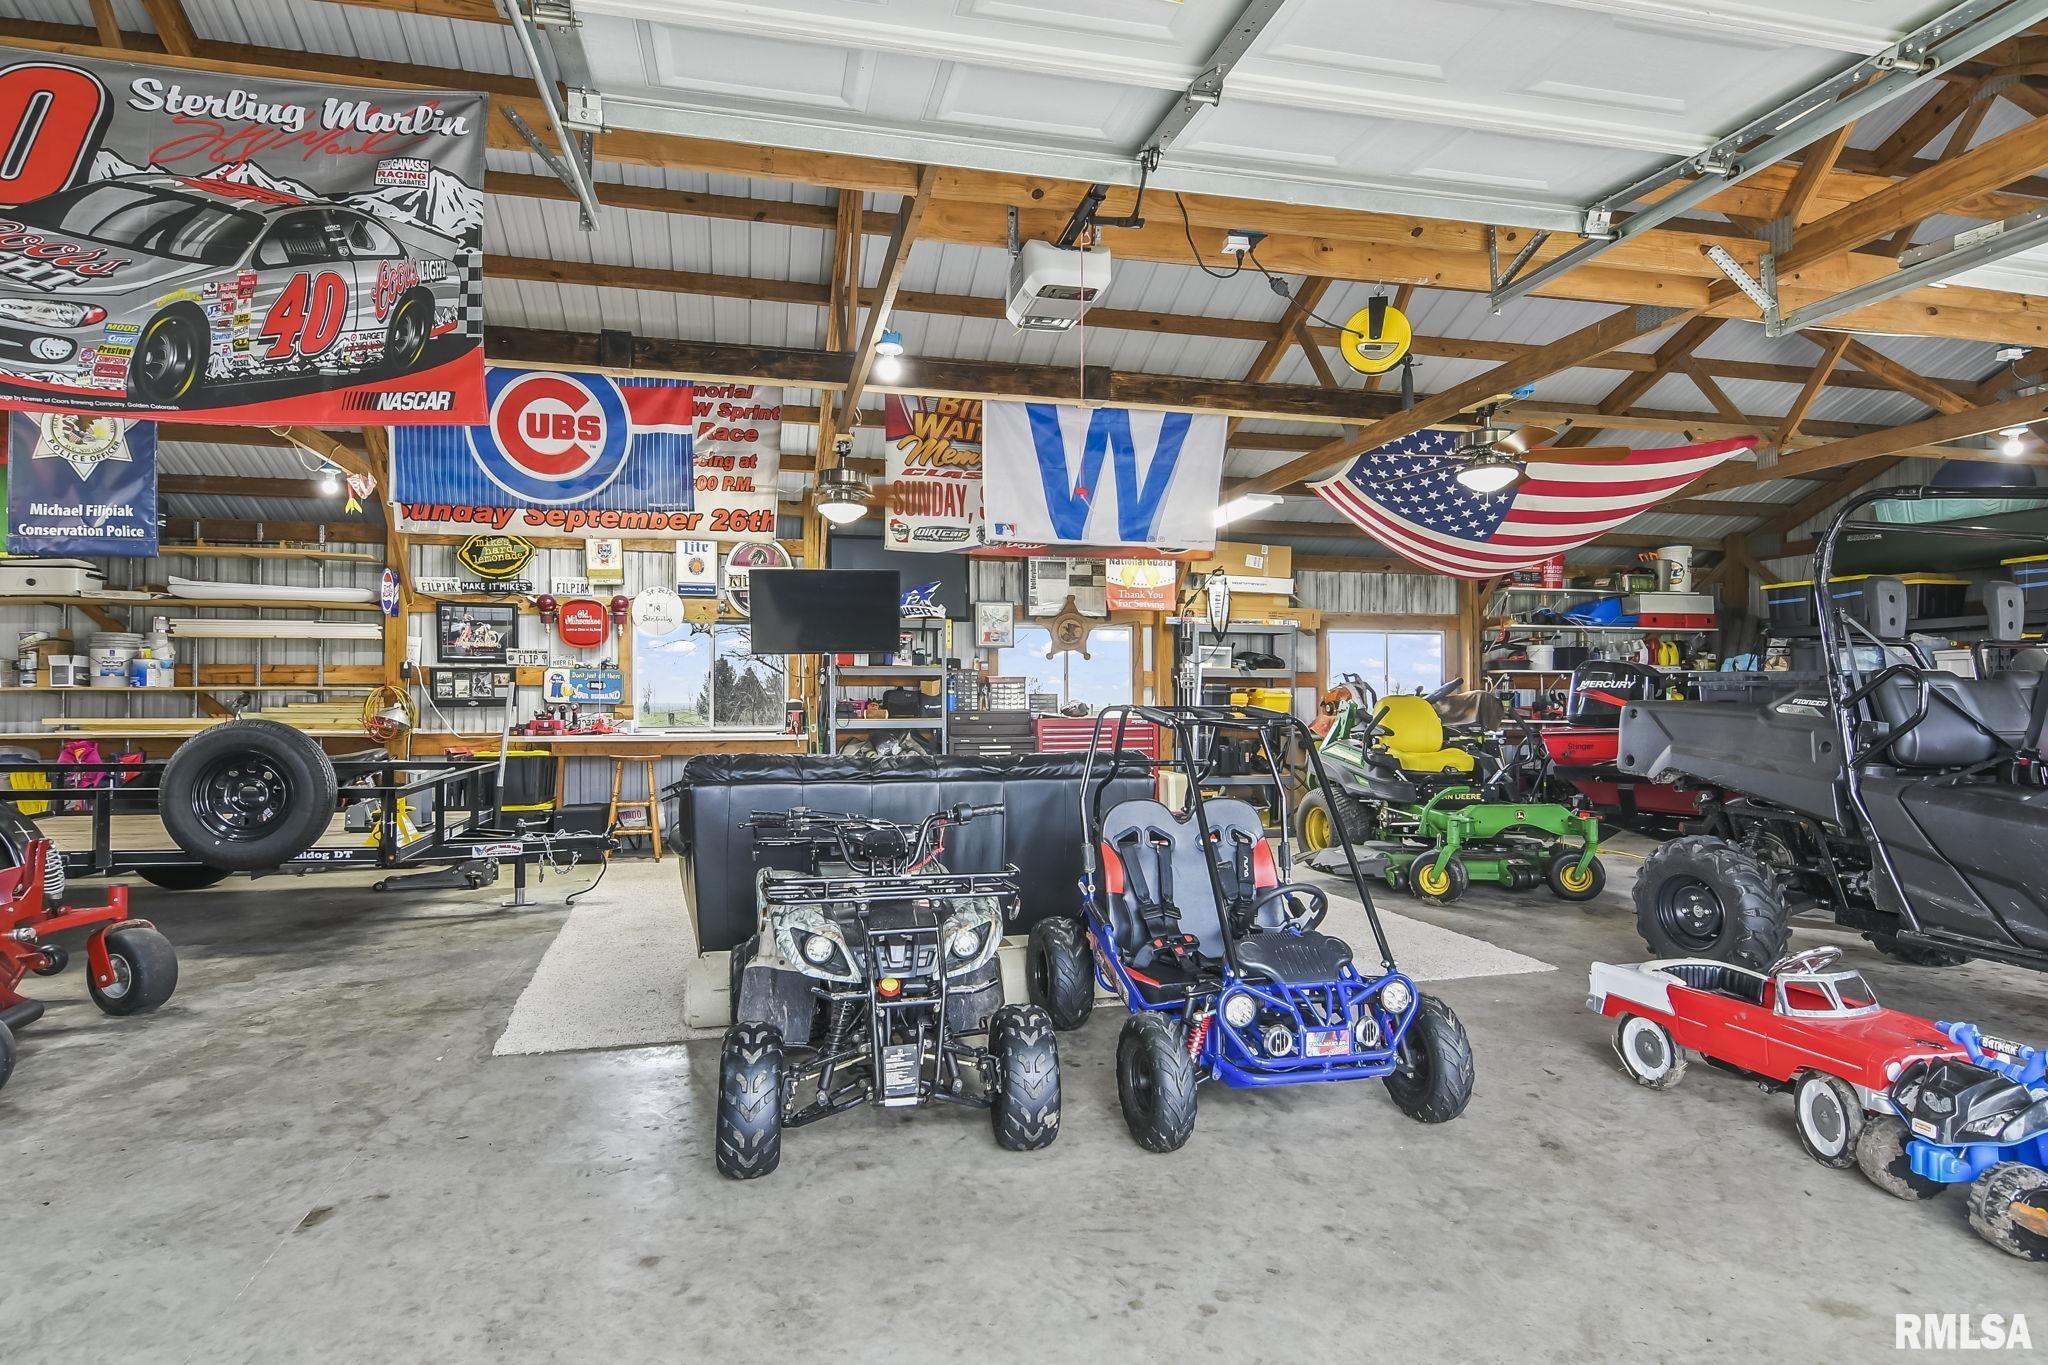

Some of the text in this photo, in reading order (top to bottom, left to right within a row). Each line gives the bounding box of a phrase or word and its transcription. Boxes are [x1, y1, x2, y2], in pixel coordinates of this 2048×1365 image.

[129, 77, 469, 136] Sterling Marlin
[391, 158, 430, 172] GANASSI
[377, 171, 427, 180] RACING
[370, 256, 448, 323] Coors LIGHT
[258, 270, 350, 361] 40
[359, 331, 385, 340] TARGET
[98, 345, 132, 355] Prestone
[377, 391, 451, 411] NASCAR
[717, 402, 780, 422] Sprint
[697, 421, 760, 443] Race
[48, 438, 121, 461] POLICE OFFICER
[739, 453, 758, 469] at
[1025, 402, 1193, 542] W
[721, 475, 756, 493] P.M.
[893, 479, 973, 524] SUNDAY,
[30, 503, 134, 519] Michael Filipiak
[523, 506, 703, 533] September
[709, 507, 775, 533] 26th
[18, 523, 145, 538] Conservation Police
[475, 537, 511, 546] mike's
[684, 541, 709, 556] Lite
[483, 545, 513, 555] hard
[472, 551, 523, 564] lemonade
[1109, 558, 1146, 567] National
[1029, 560, 1038, 590] Volleyball
[421, 581, 457, 592] FILPIAK
[461, 582, 486, 591] MAKE
[489, 583, 497, 591] IT
[556, 582, 590, 594] FILPIAK
[1118, 589, 1164, 599] Thank You
[1119, 600, 1165, 610] For Serving
[565, 615, 601, 625] Milwaukee
[576, 609, 589, 618] Old
[518, 654, 539, 664] FLIP
[1576, 680, 1637, 692] MERCURY
[333, 850, 353, 859] DT
[1982, 1036, 2020, 1056] BATMAN
